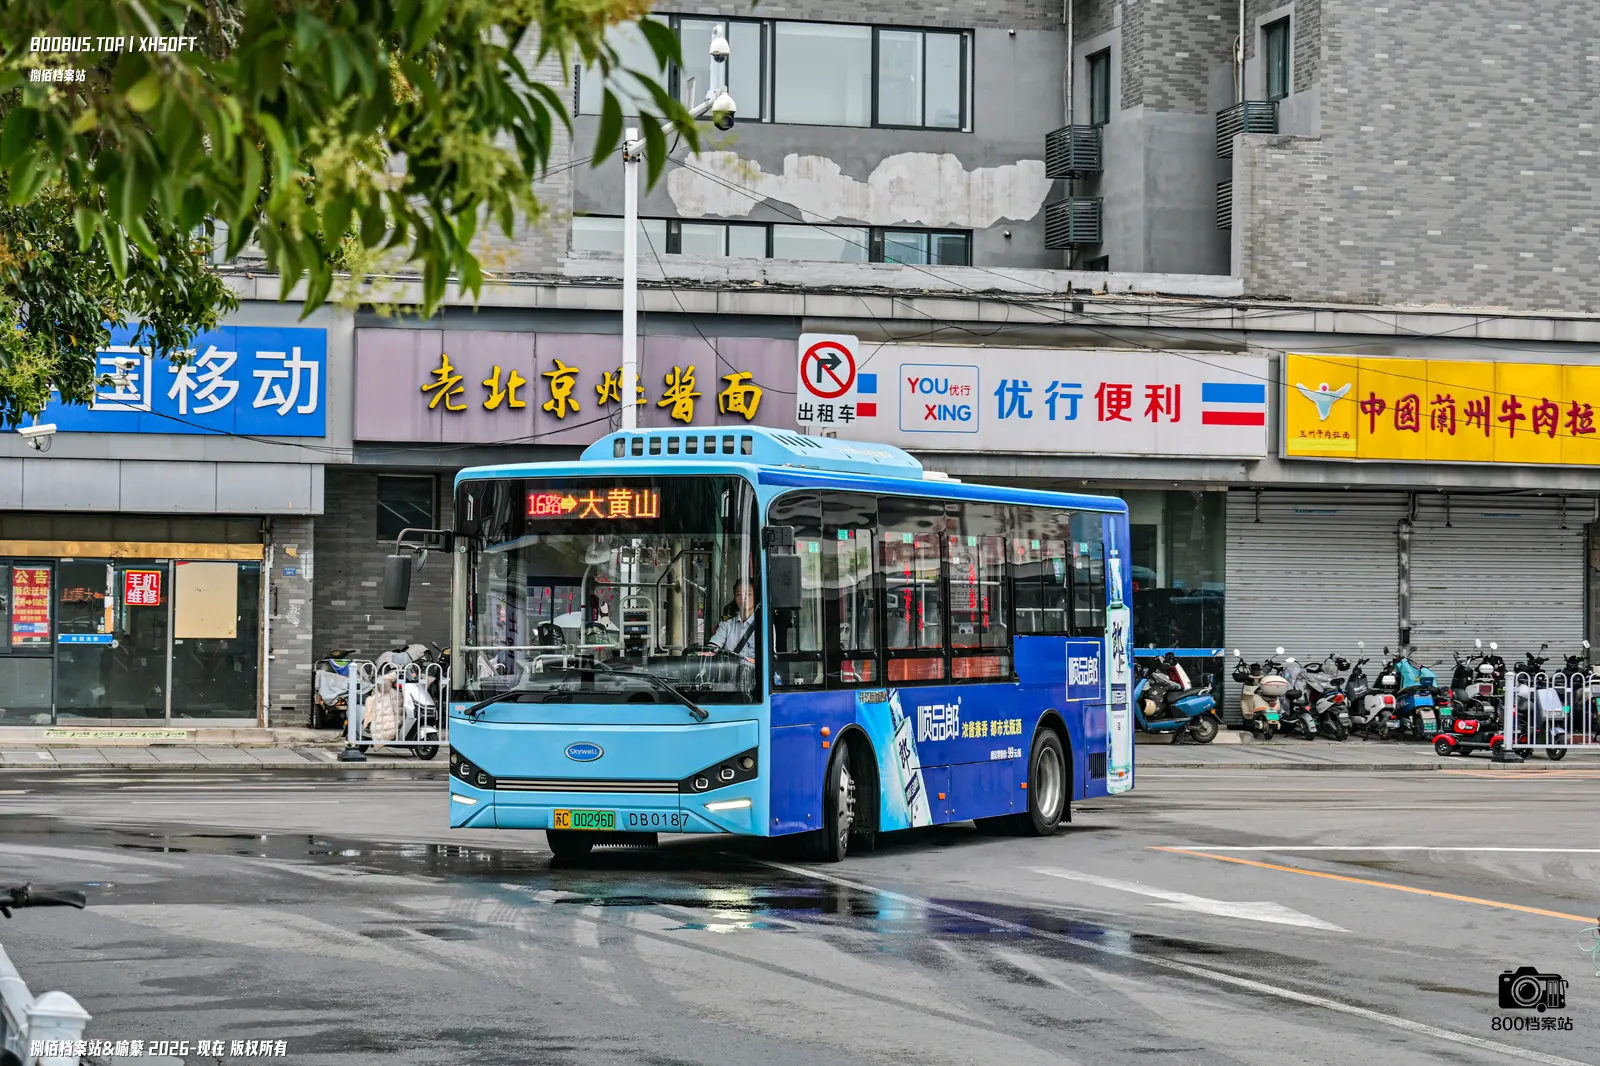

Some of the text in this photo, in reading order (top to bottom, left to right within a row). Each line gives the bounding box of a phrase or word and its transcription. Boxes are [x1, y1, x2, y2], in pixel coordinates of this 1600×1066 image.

[42, 345, 319, 416] 国移动
[907, 377, 971, 396] YOU 优行
[994, 379, 1181, 423] 优行便利
[798, 402, 855, 423] 出租车
[924, 403, 972, 421] XING
[528, 489, 657, 518] 16路 大黄山
[15, 570, 48, 584] 公告
[128, 574, 157, 588] 手机
[127, 589, 157, 603] 维修
[1068, 656, 1098, 686] 顺品郎
[917, 703, 960, 742] 顺品郎
[574, 812, 614, 828] 00296D
[629, 812, 689, 827] DB0187
